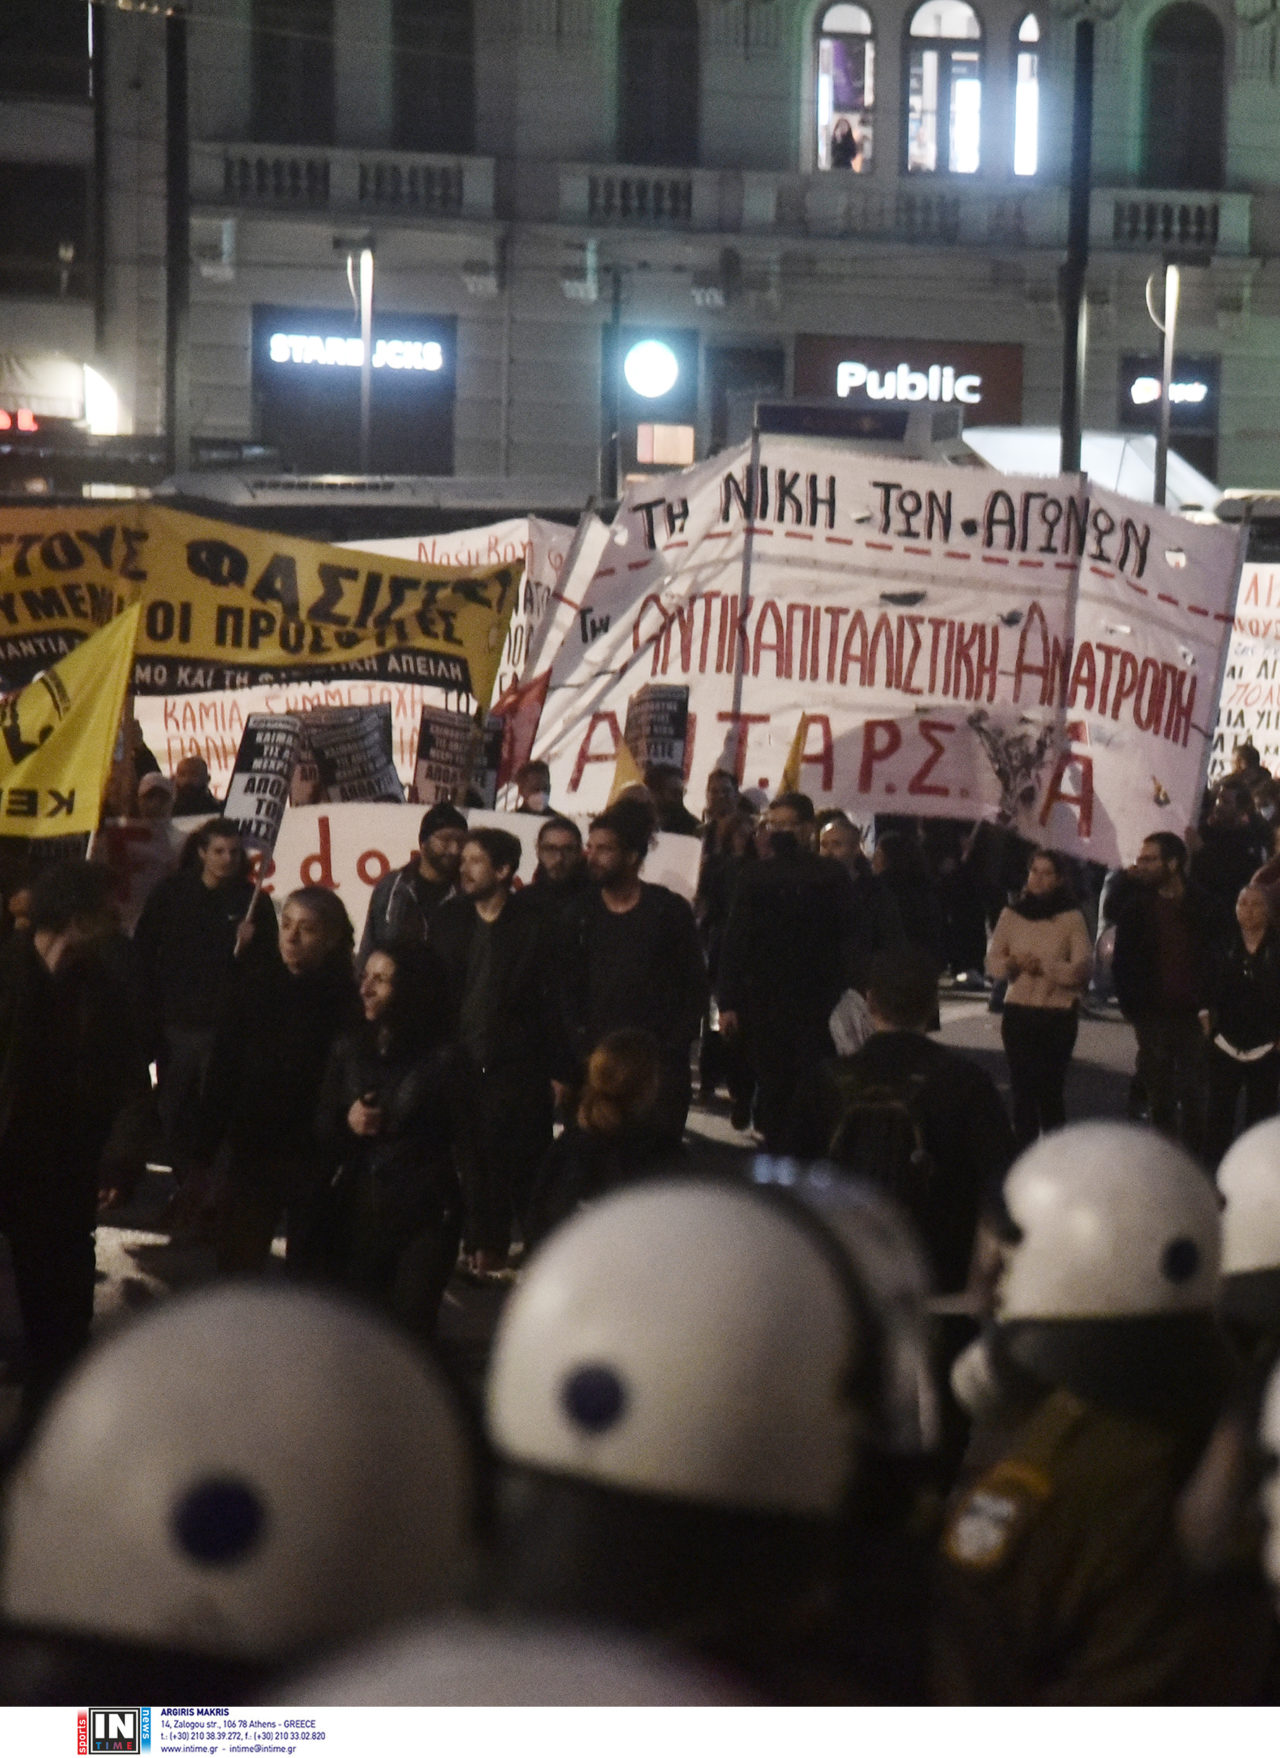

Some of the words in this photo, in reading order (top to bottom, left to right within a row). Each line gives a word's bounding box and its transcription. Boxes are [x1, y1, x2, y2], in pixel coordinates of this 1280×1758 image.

[837, 361, 982, 403] Public
[720, 465, 836, 528] ΝΙΚΗ
[146, 600, 192, 643] ΟΙ
[177, 665, 214, 688] ΚΑΙ
[387, 654, 463, 681] ΑΠΕΙΛΗ
[1013, 601, 1196, 748] ΑΝΑΤΡΟΠΗ
[164, 698, 243, 732] ΚΑΜΙΑ
